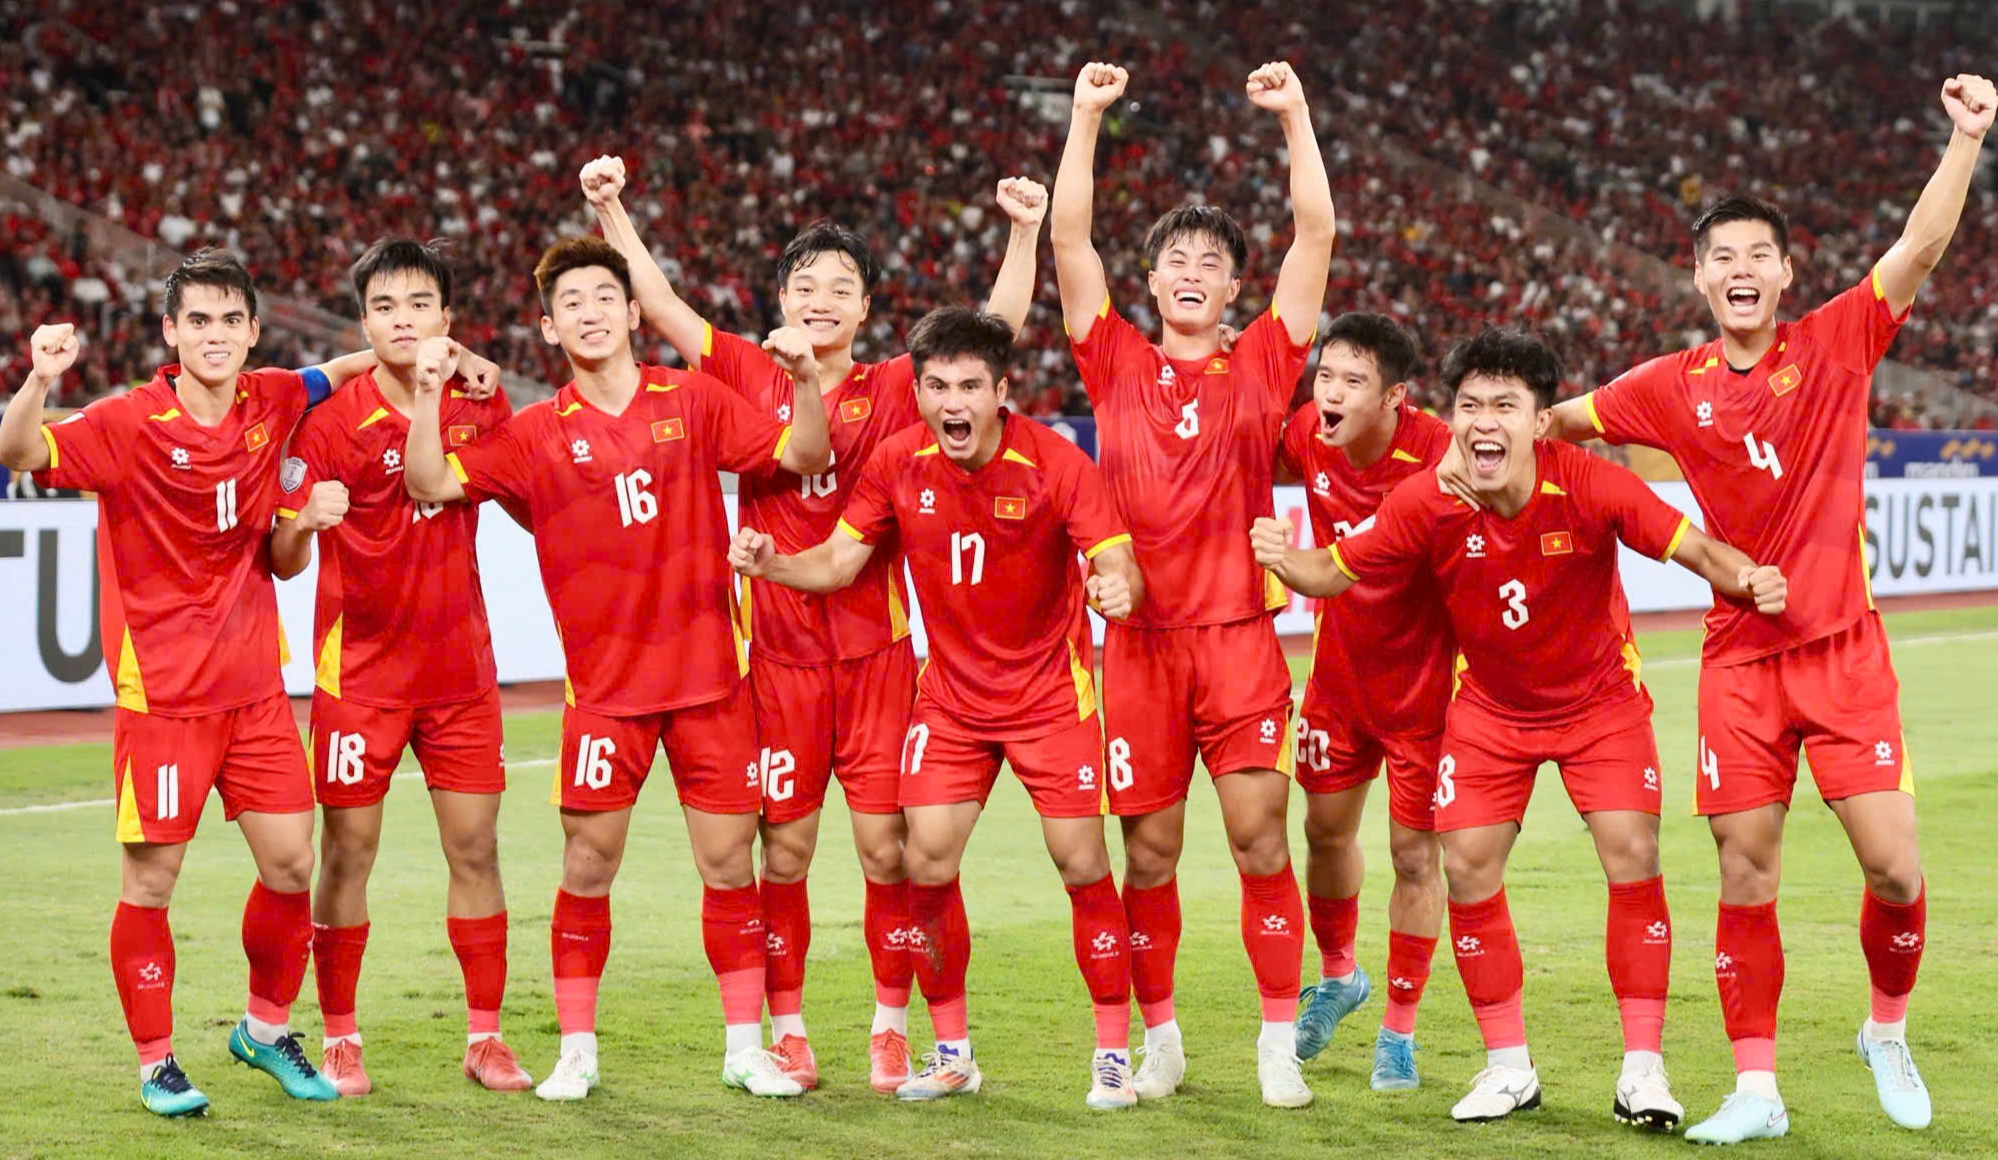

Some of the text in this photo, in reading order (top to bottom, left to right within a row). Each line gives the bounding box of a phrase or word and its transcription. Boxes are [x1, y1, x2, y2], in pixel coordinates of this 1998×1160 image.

[1743, 431, 1784, 480] 4
[215, 477, 238, 533] 11
[614, 468, 658, 528] 16
[951, 531, 985, 585] 17
[1498, 579, 1530, 630] 3
[327, 730, 366, 785] 18
[574, 733, 616, 790] 16
[761, 747, 795, 802] 12
[1109, 736, 1134, 792] 8
[1433, 753, 1456, 809] 3
[1700, 735, 1721, 791] 4
[157, 763, 179, 820] 11
